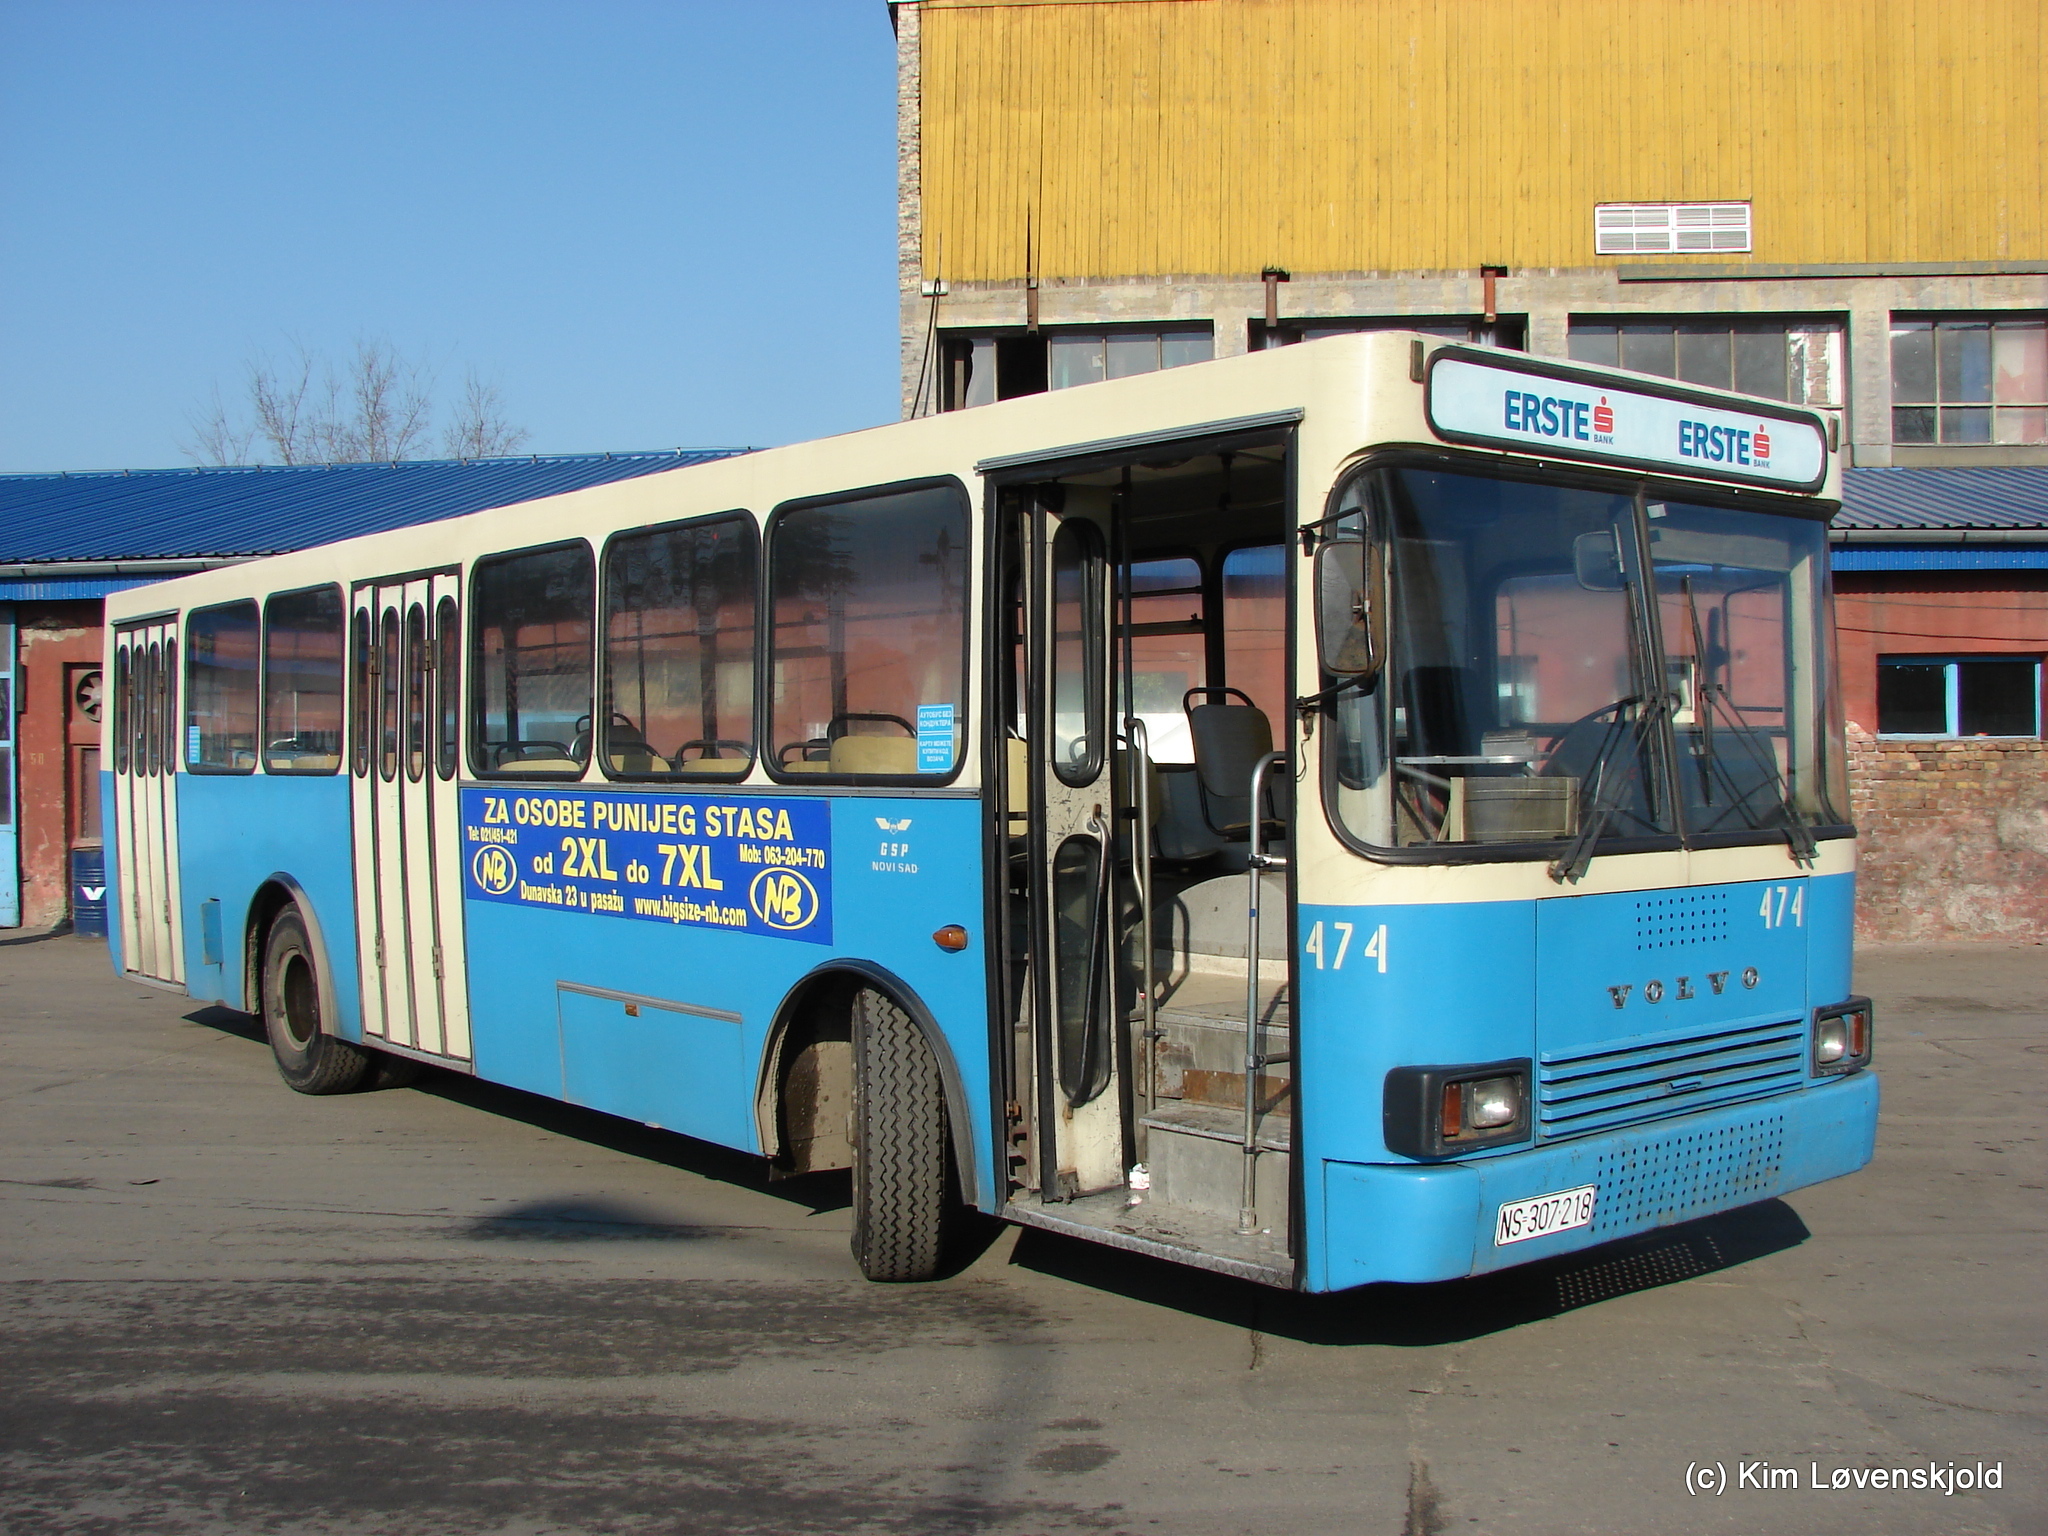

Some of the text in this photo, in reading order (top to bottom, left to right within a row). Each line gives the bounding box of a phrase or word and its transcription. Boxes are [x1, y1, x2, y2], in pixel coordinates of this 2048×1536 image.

[1504, 389, 1589, 441] ERSTE
[1594, 434, 1614, 445] BANK
[1679, 419, 1750, 466] ERSTE
[1753, 459, 1771, 469] BANK
[467, 825, 479, 841] Tel:
[484, 797, 794, 841] ZA OSOBE PUNIJEG STASA
[533, 836, 723, 891] od 2XL do 7XL
[739, 843, 825, 869] Mob: 063-204-770
[880, 842, 909, 857] GSP
[872, 861, 918, 873] NOVI SAD
[520, 880, 624, 913] Dunavska 23 u pasažu
[634, 895, 747, 927] www.bigsize-nb.com
[1759, 886, 1804, 930] 474
[1305, 920, 1387, 974] 474
[1606, 966, 1760, 1010] VOLVO
